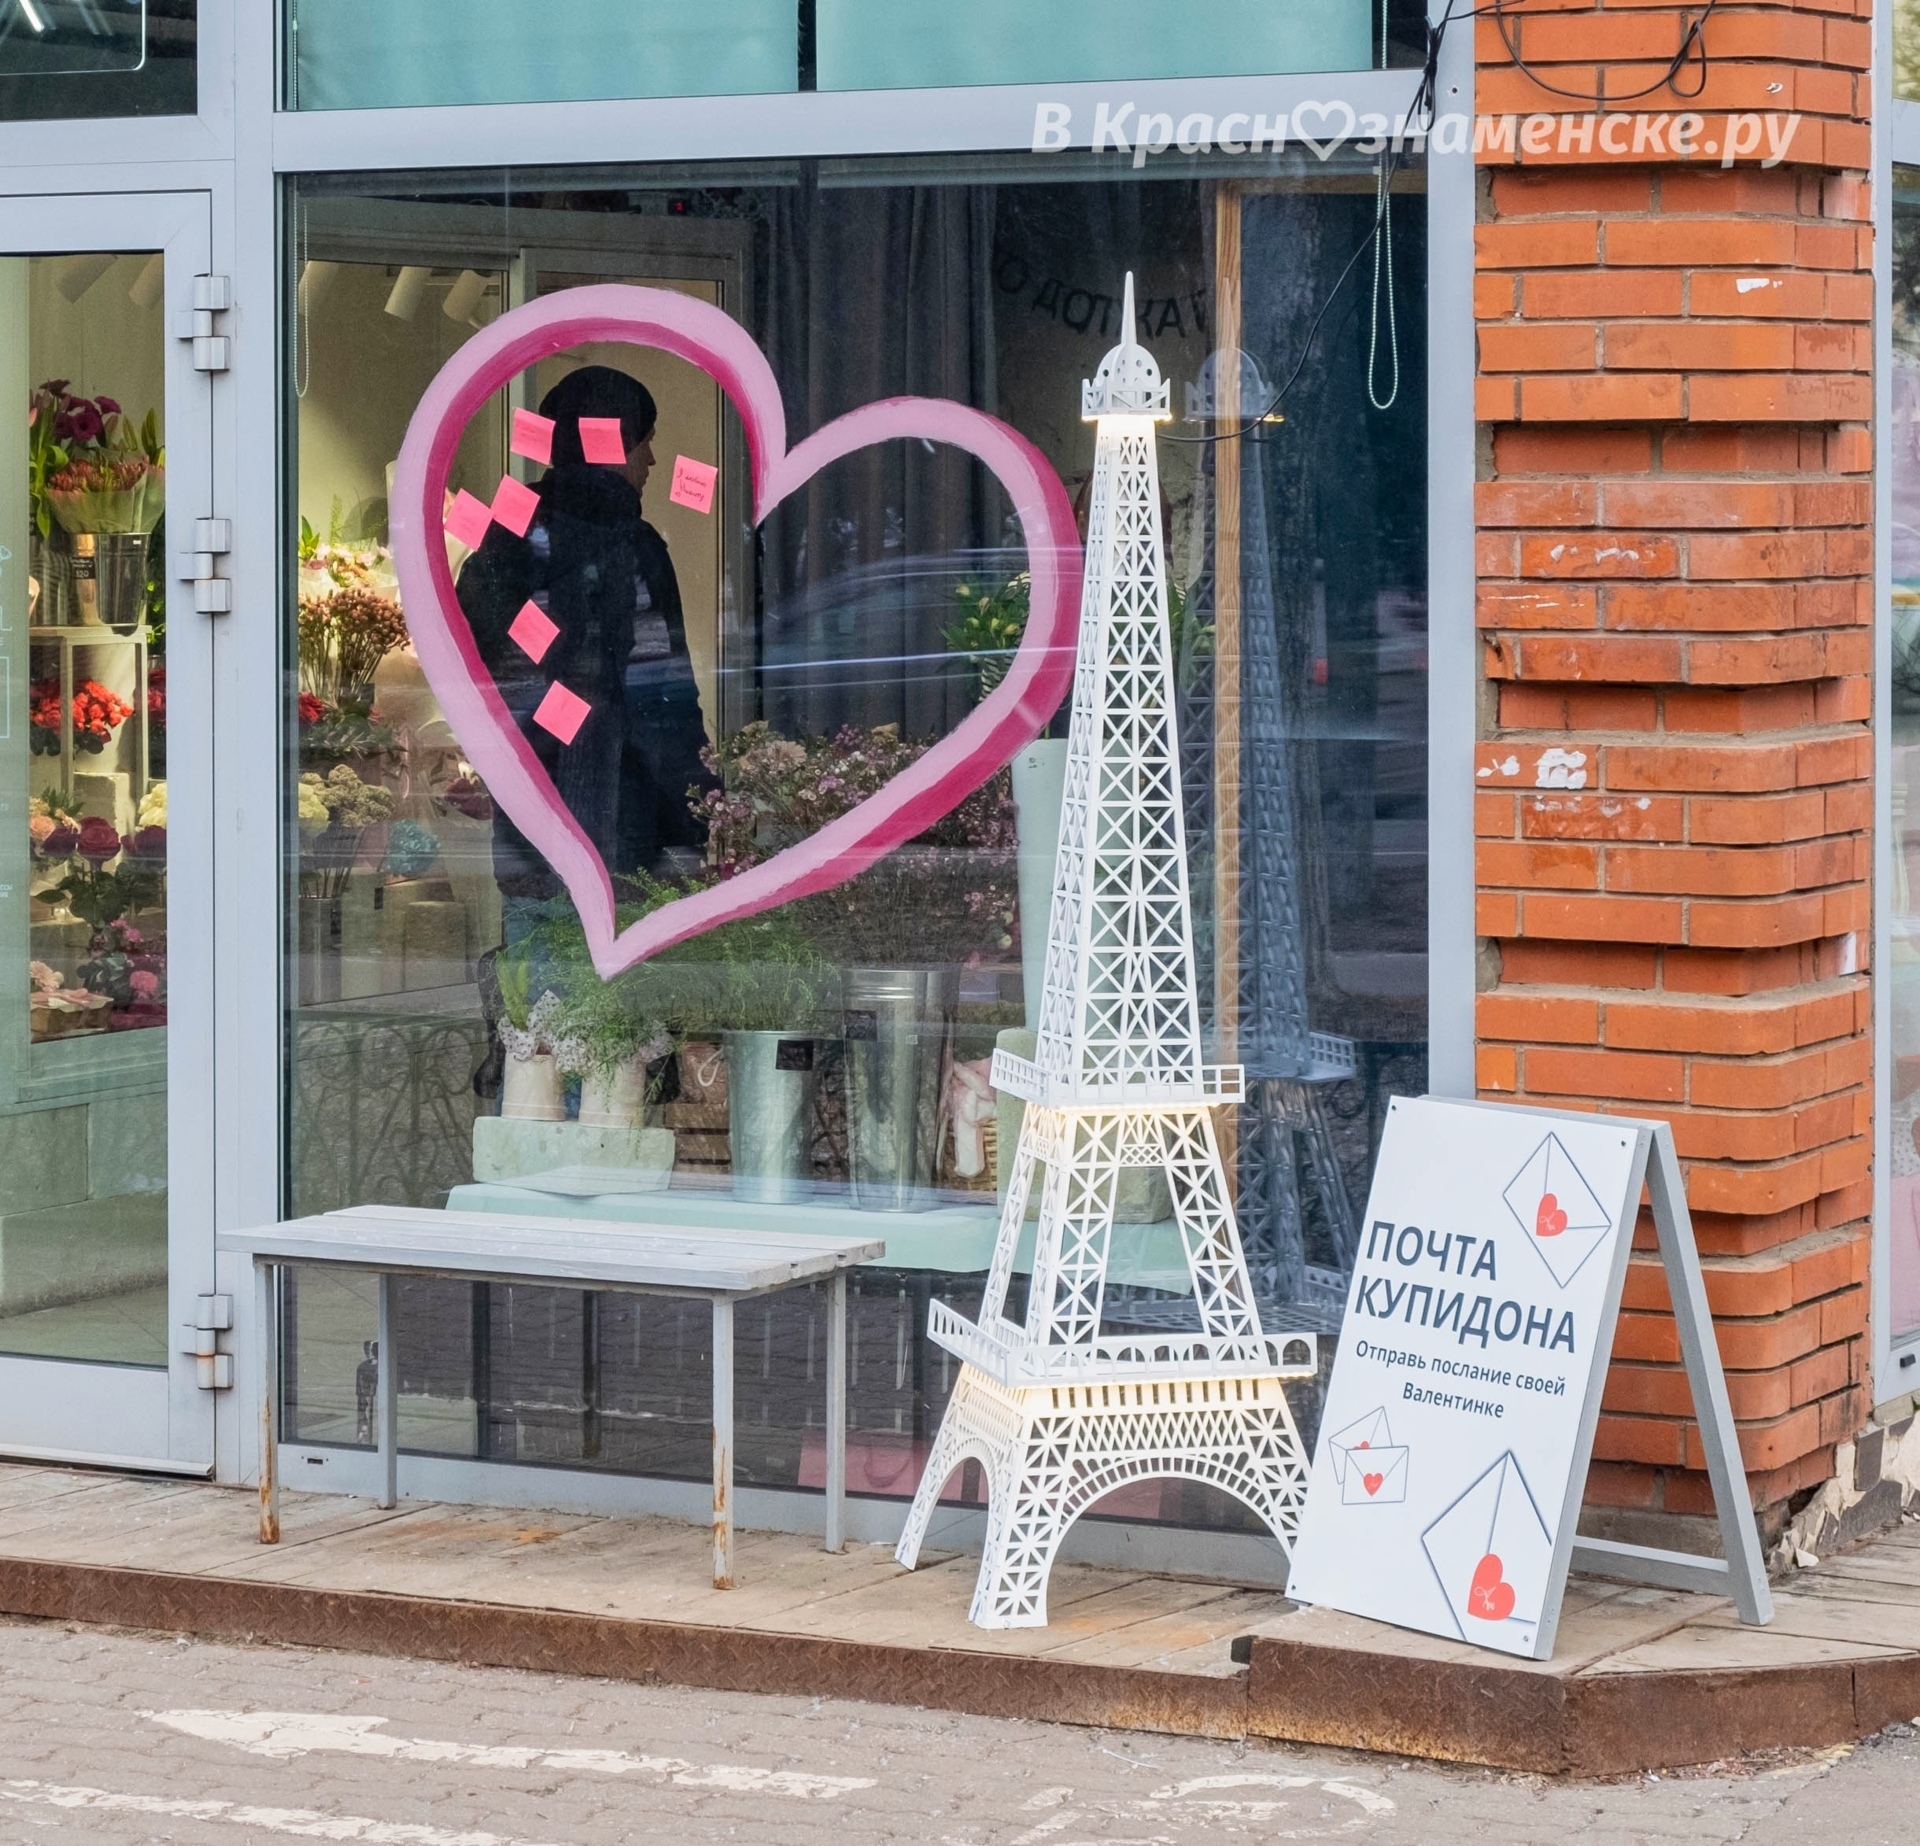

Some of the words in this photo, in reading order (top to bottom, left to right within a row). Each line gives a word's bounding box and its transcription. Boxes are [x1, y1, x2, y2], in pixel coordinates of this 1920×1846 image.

[1366, 1220, 1497, 1281] ПОЧТА
[1354, 1275, 1576, 1354] КУПИДОНА
[1355, 1340, 1427, 1369] Отправь
[1431, 1358, 1512, 1386] послание
[1515, 1375, 1567, 1397] своей
[1402, 1381, 1505, 1419] Валентинке
